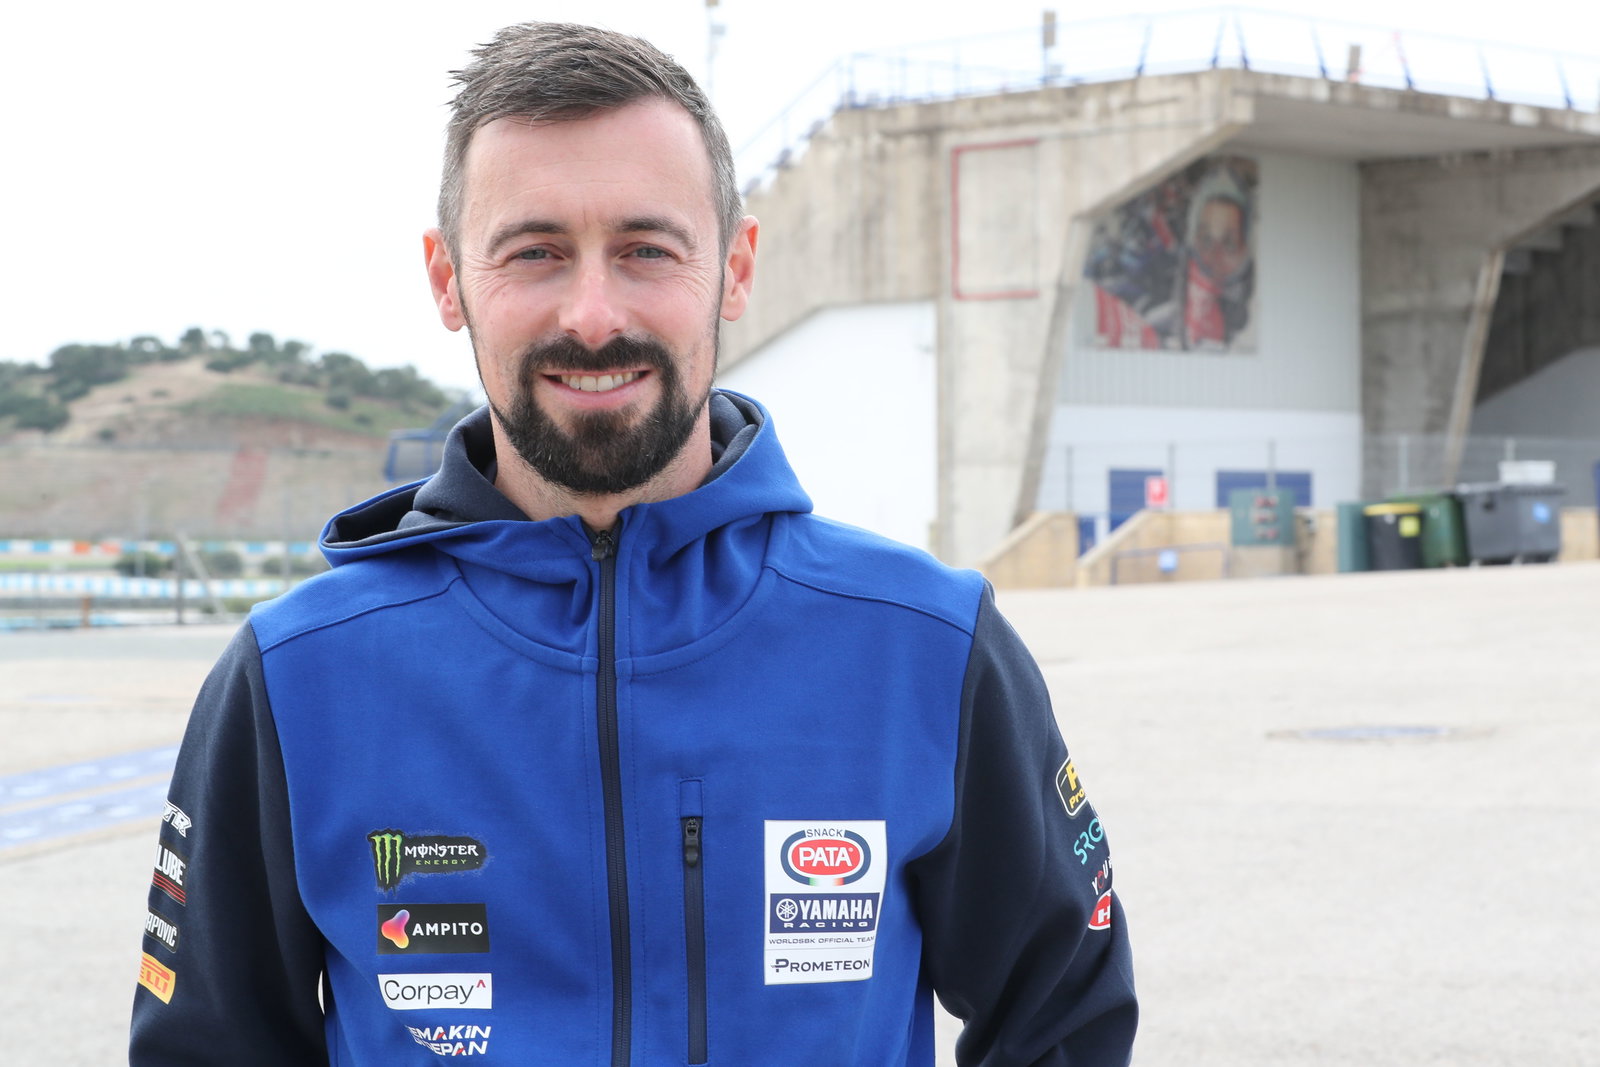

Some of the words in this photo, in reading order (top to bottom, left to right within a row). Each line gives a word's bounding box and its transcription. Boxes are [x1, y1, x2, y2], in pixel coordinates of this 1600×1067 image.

[806, 828, 844, 838] SNACK
[404, 843, 479, 858] MONSTER
[799, 847, 853, 867] PATA
[799, 899, 873, 920] YAMAHA
[412, 922, 483, 936] AMPITO
[769, 937, 816, 945] WORLDSBK
[775, 958, 871, 974] PROMETEON
